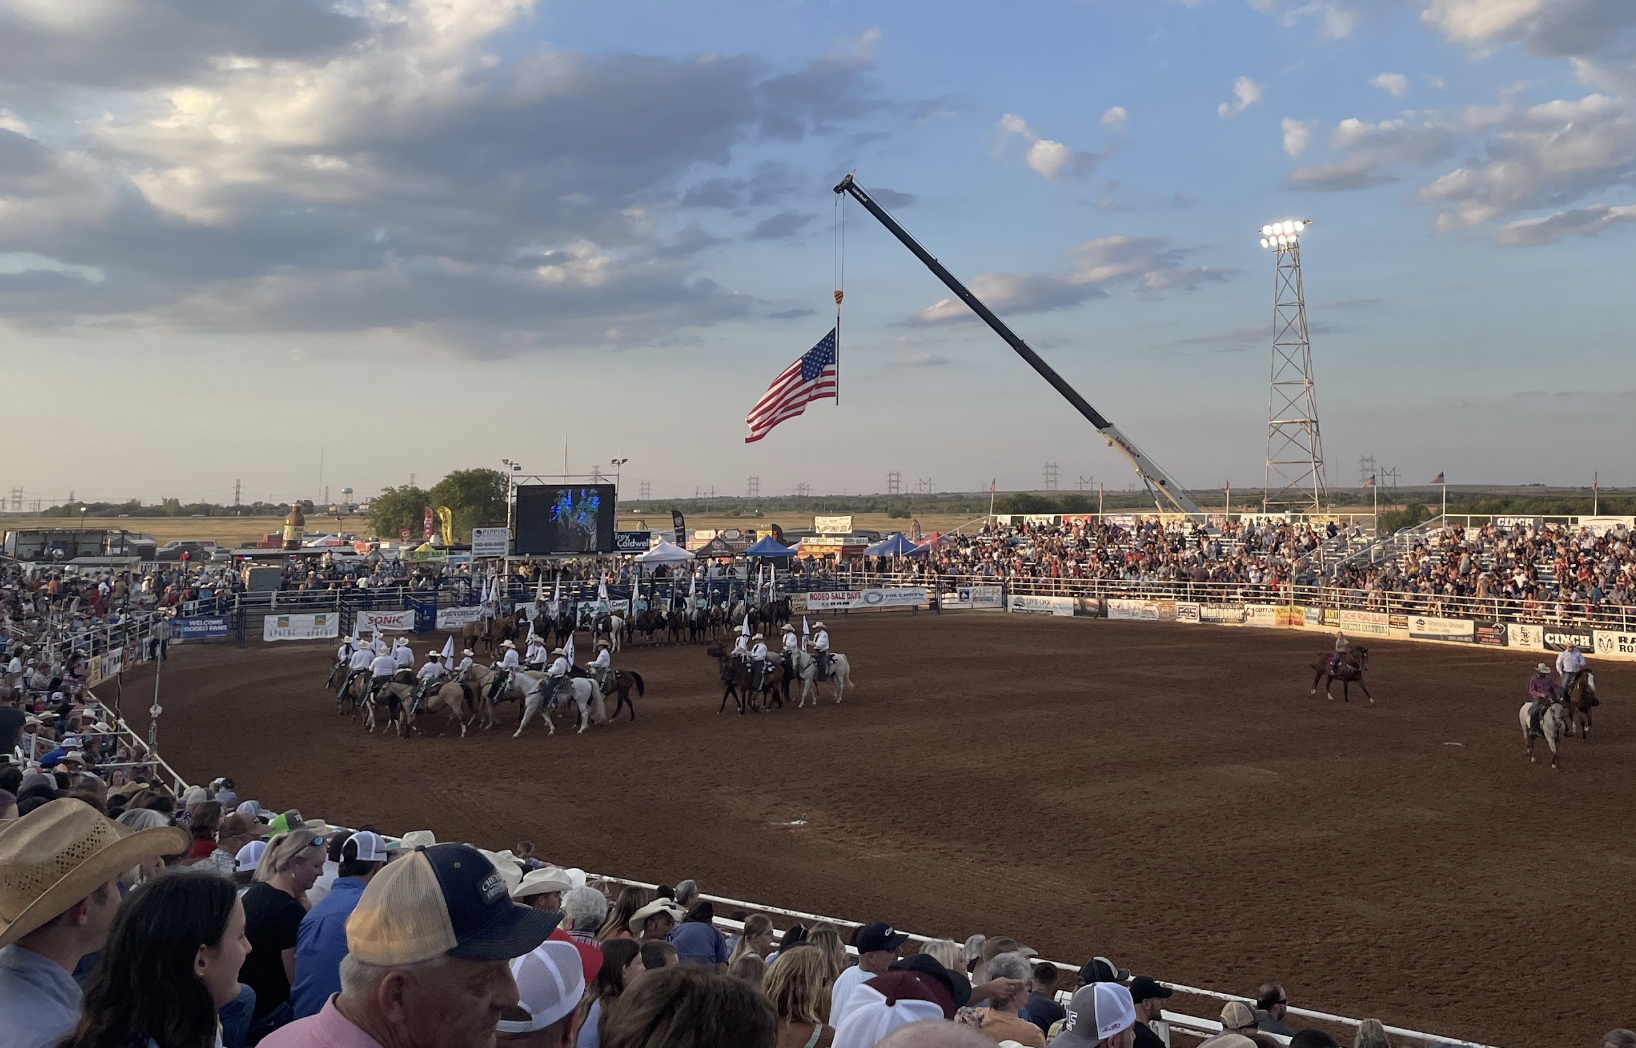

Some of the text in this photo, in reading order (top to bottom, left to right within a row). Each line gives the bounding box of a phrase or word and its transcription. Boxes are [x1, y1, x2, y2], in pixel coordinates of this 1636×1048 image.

[1497, 517, 1534, 527] CINCH
[614, 532, 631, 541] Trey
[809, 592, 830, 601] RODEO
[831, 592, 846, 600] SALE
[847, 591, 862, 600] DAYS
[1201, 606, 1244, 620] Montgomer
[1341, 611, 1357, 621] CACHE
[1357, 612, 1371, 622] ROAD
[1371, 614, 1388, 623] GLASS
[367, 615, 403, 625] SONIC
[269, 629, 296, 637] APACHE
[306, 629, 333, 637] APACHE
[1544, 633, 1590, 646] CINCH
[1618, 636, 1636, 645] RA
